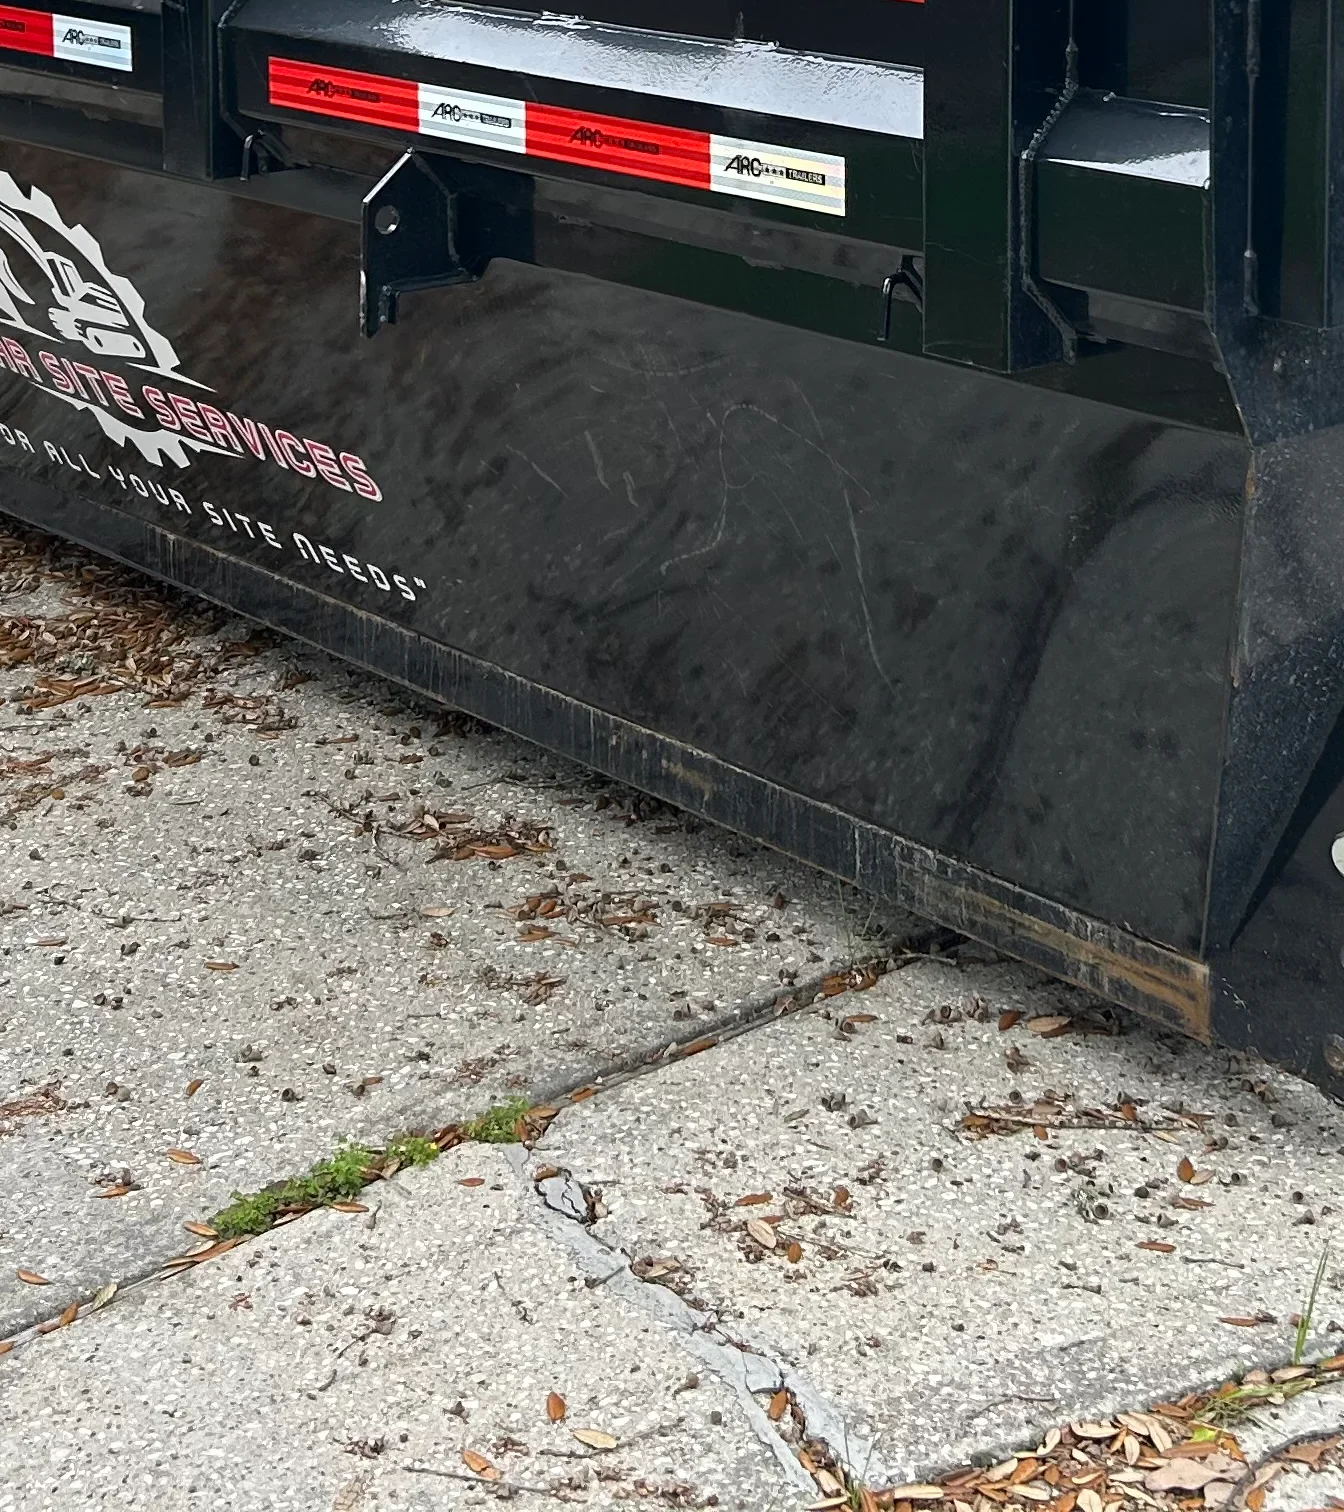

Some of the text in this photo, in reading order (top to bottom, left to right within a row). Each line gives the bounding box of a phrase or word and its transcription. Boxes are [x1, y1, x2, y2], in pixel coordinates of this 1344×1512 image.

[431, 102, 462, 122] ARC
[723, 154, 825, 185] ARC TRAILERS
[38, 350, 145, 419] SITE
[142, 385, 384, 502] SERVICES
[43, 440, 101, 479] ALL
[108, 465, 193, 515] YOUR
[202, 501, 283, 549] SITE
